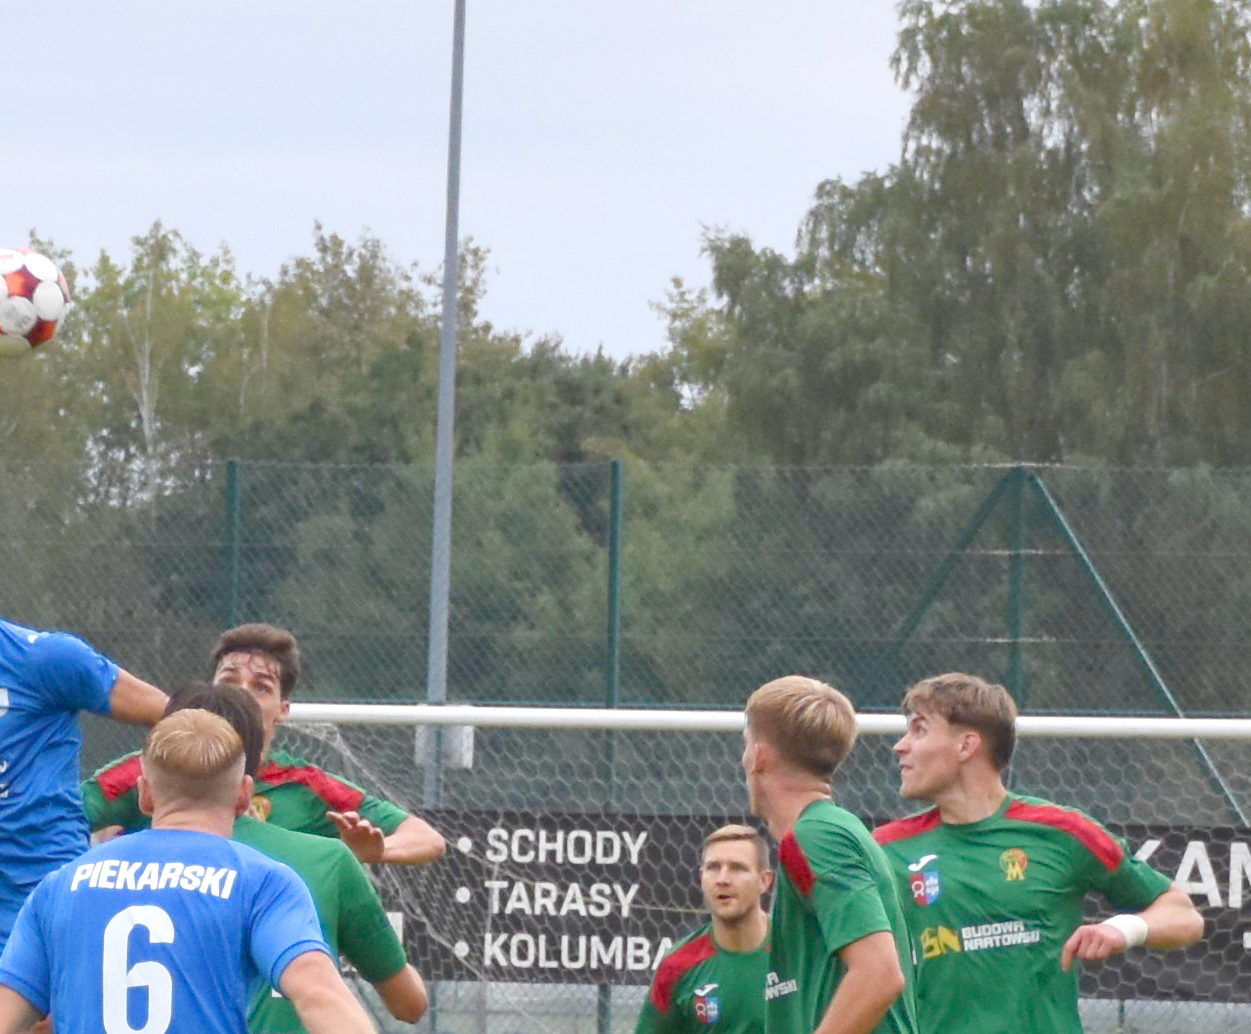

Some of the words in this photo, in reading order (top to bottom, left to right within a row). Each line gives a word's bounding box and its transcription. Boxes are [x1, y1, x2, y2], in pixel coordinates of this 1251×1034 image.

[485, 828, 648, 865] SCHODY
[70, 859, 238, 900] PIEKARSKI
[483, 880, 639, 918] TARASY
[961, 920, 1025, 939] BUDOWA
